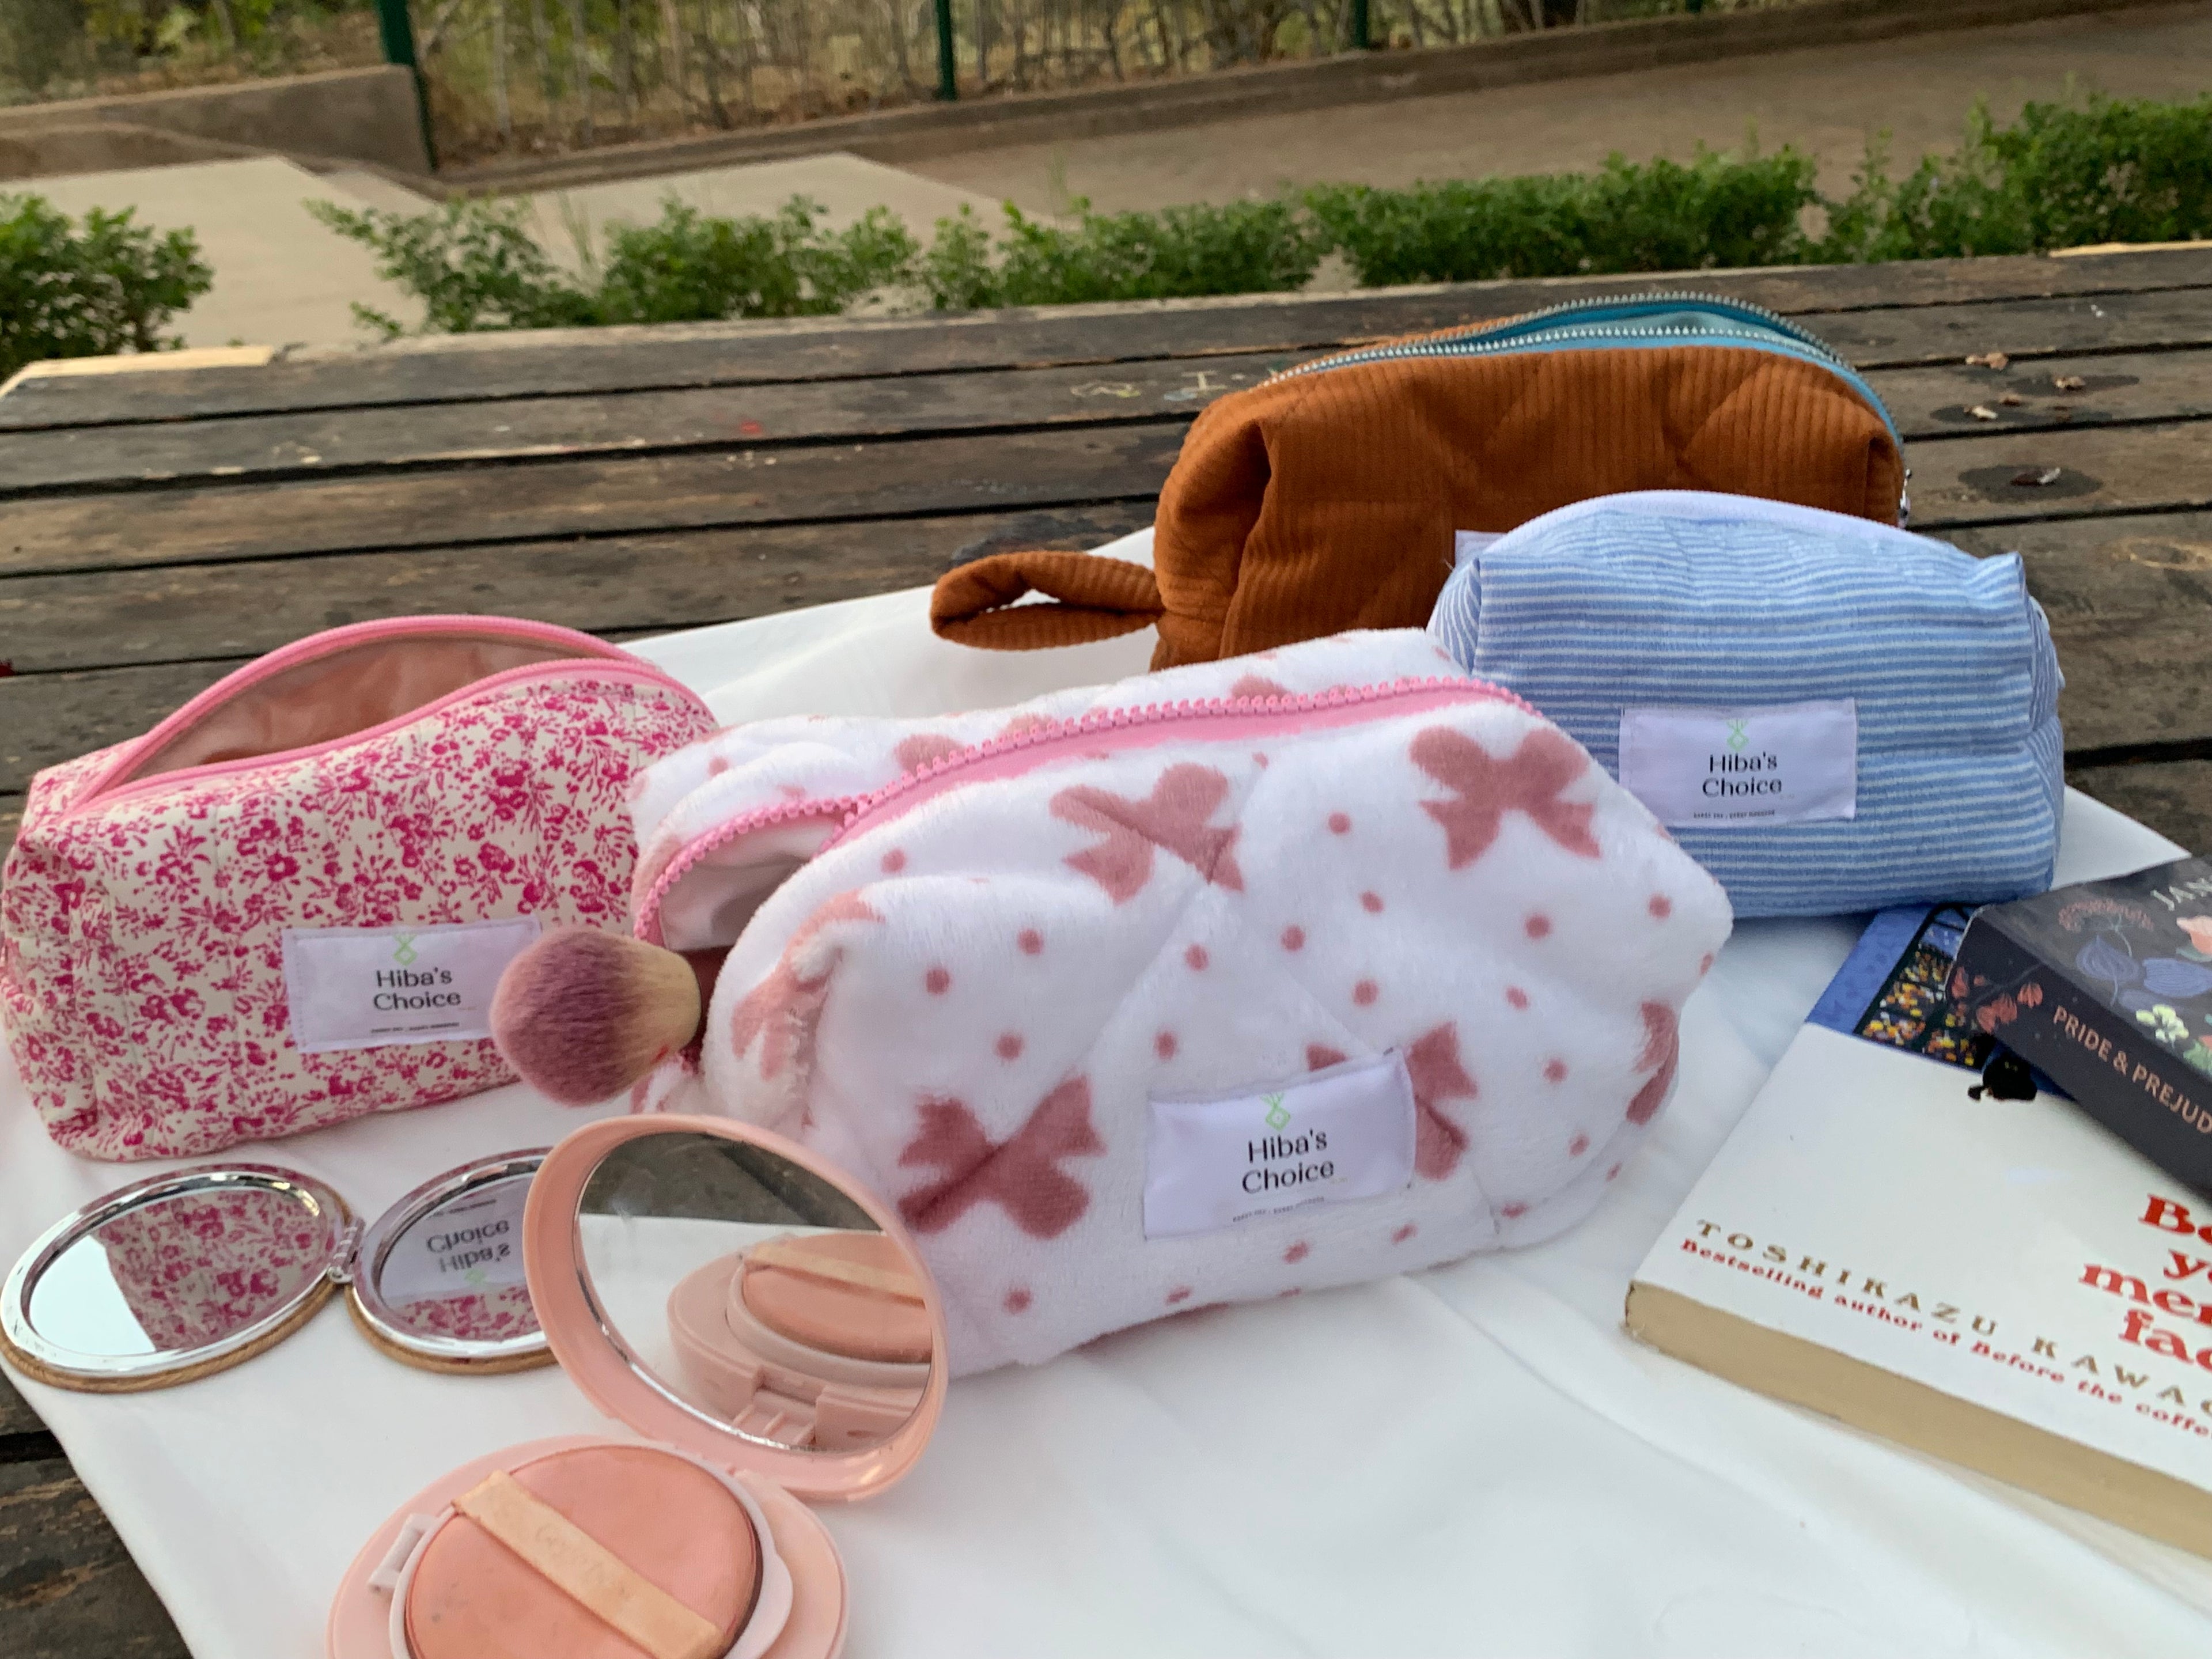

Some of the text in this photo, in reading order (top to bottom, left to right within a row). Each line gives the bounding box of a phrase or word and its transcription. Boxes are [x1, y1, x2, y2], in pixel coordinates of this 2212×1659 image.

[1709, 751, 1778, 774] Hiba's
[1702, 776, 1783, 798] Choice
[2150, 875, 2212, 912] JAN
[376, 967, 453, 988] Hiba's
[373, 991, 461, 1011] Choice
[2053, 1005, 2113, 1063] PRIDE
[2112, 1050, 2128, 1077] &
[1248, 1128, 1328, 1164] Hiba's
[1241, 1160, 1335, 1195] Choice
[1696, 1219, 1999, 1337] TOSHIKAZU
[2162, 1247, 2212, 1284] y
[2077, 1263, 2212, 1327] me
[1680, 1237, 2212, 1440] Bestselling author of Before the coffe
